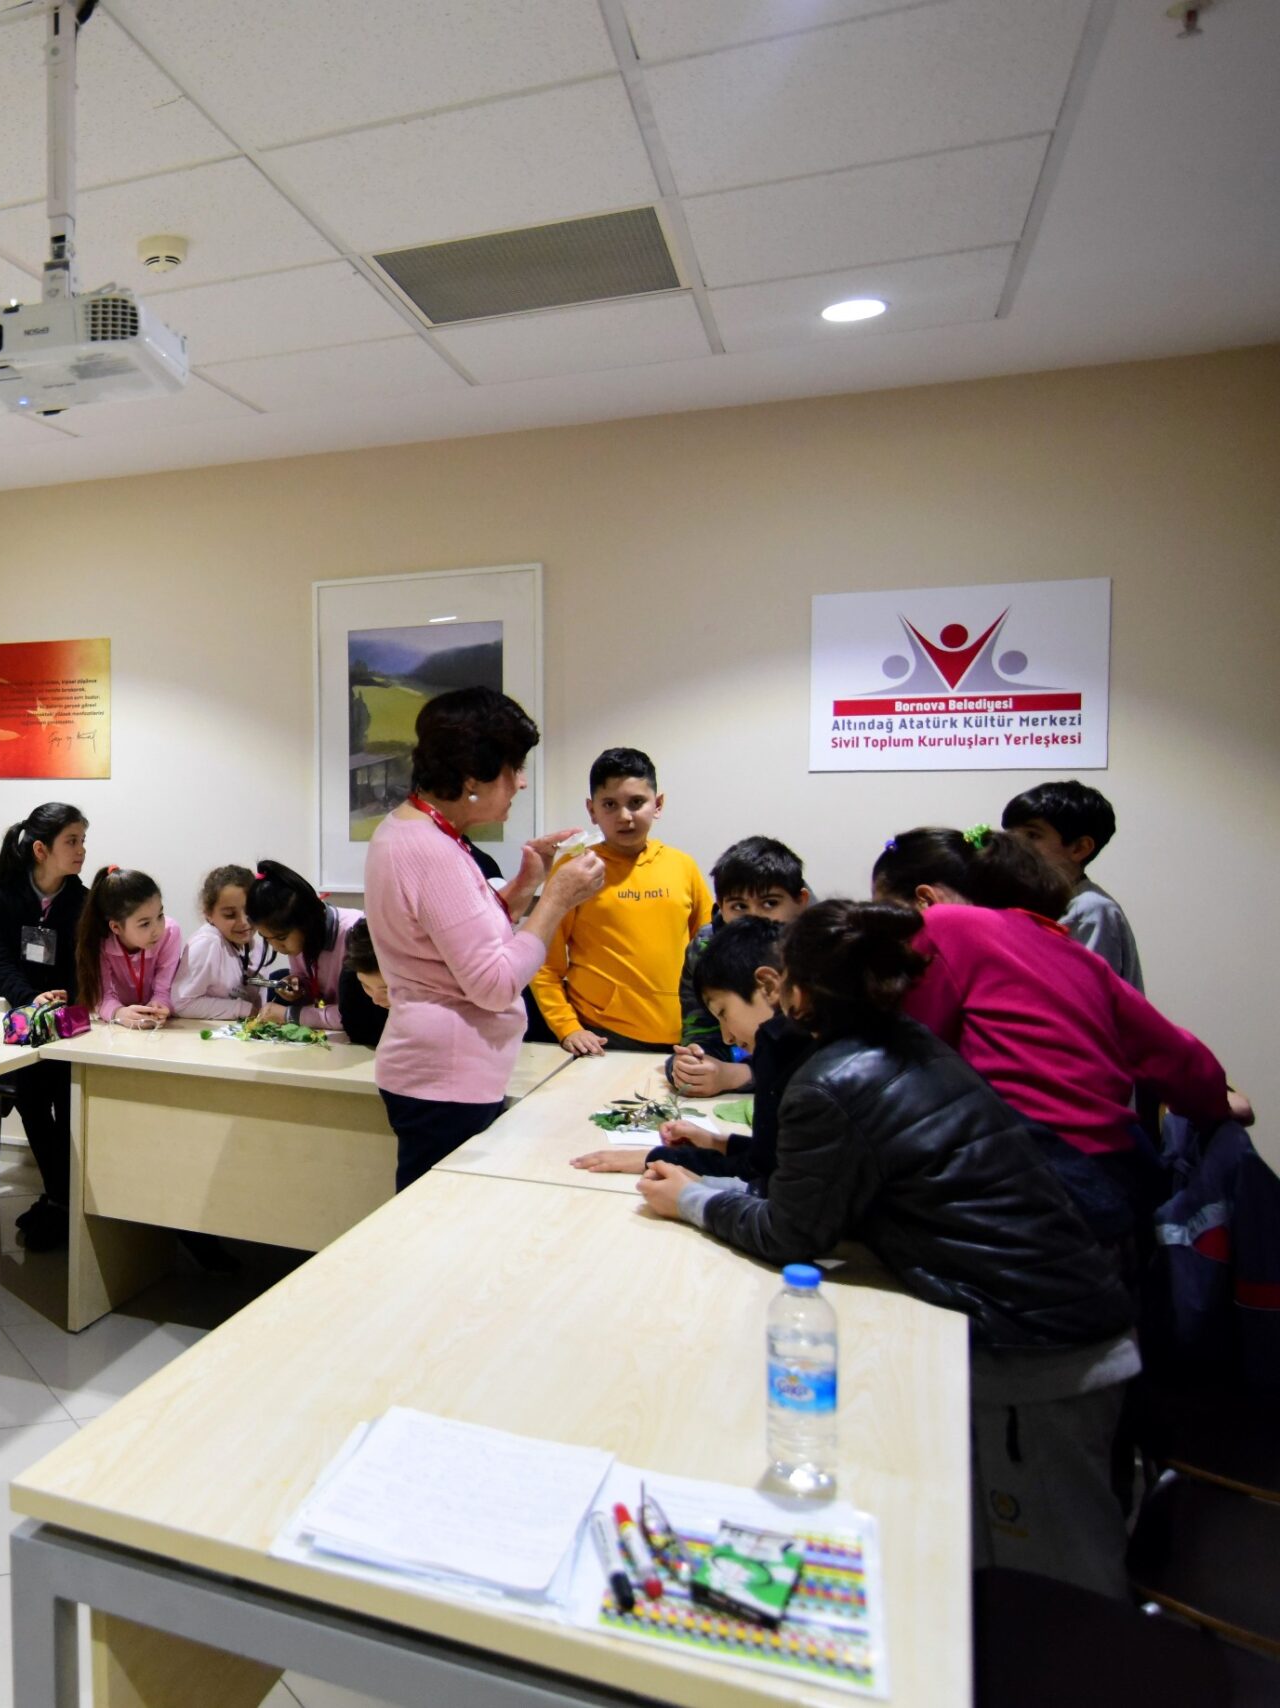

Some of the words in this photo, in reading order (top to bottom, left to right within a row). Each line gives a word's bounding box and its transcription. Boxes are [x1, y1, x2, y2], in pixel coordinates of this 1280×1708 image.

[895, 701, 946, 712] Bornova
[948, 698, 1013, 712] Belediyesi
[832, 719, 893, 733] Altındağ
[899, 717, 958, 730] Atatürk
[963, 716, 1013, 729] Kültür
[1019, 714, 1081, 727] Merkezi
[831, 736, 859, 748] Sivil
[864, 735, 913, 751] Toplum
[918, 733, 999, 749] Kuruluşları
[1004, 732, 1081, 748] Yerleşkesi
[618, 888, 640, 901] why
[644, 888, 663, 898] not
